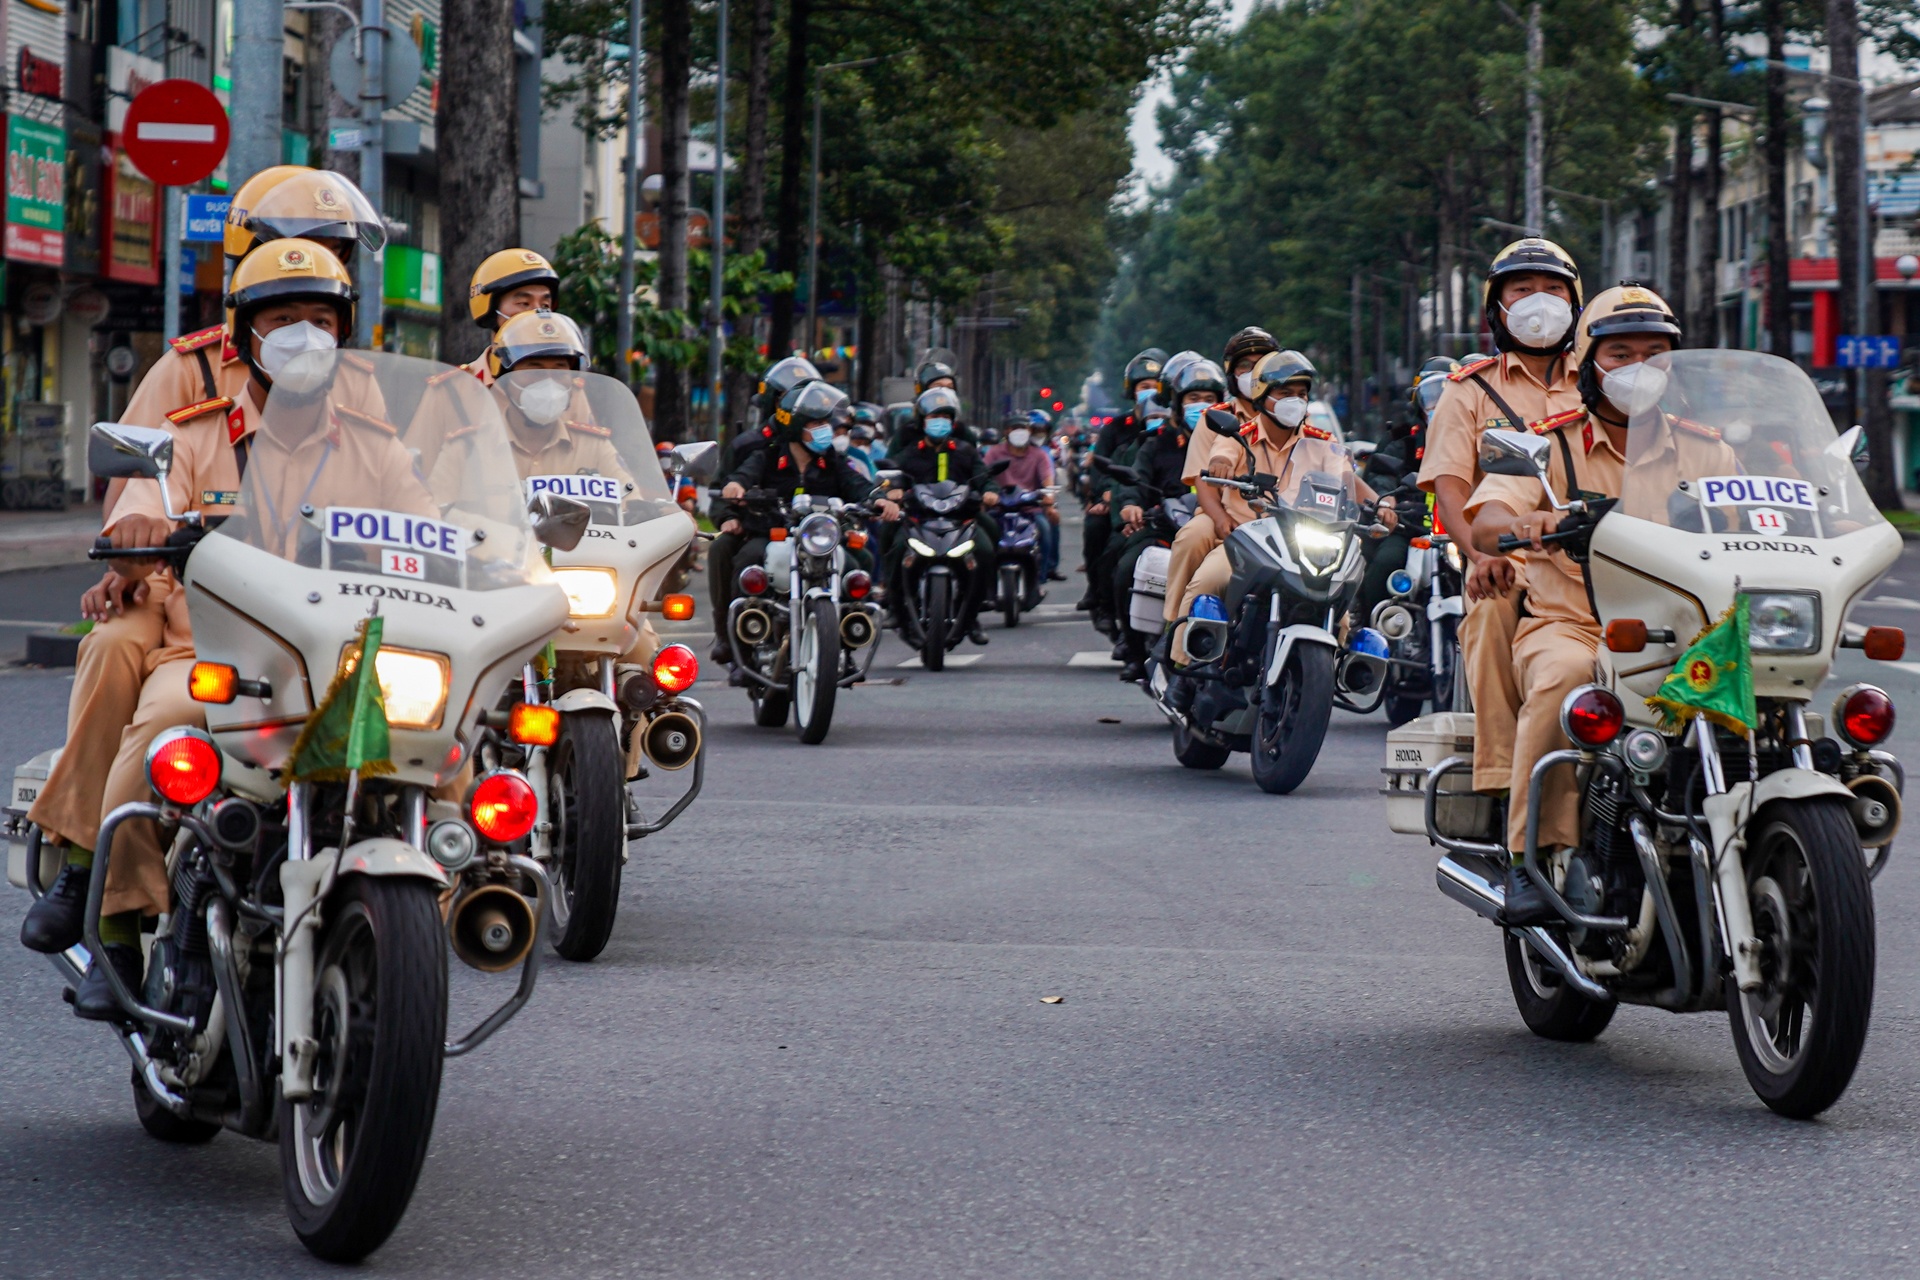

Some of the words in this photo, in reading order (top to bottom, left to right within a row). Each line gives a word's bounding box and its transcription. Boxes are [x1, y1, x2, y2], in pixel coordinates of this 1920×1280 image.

[531, 477, 618, 499] POLICE
[1705, 479, 1813, 507] POLICE
[1318, 494, 1333, 505] 02
[1756, 513, 1781, 528] 11
[331, 511, 458, 555] POLICE
[1721, 541, 1818, 556] HONDA
[390, 554, 419, 574] 18
[338, 582, 458, 612] HONDA
[1395, 749, 1422, 762] HONDA
